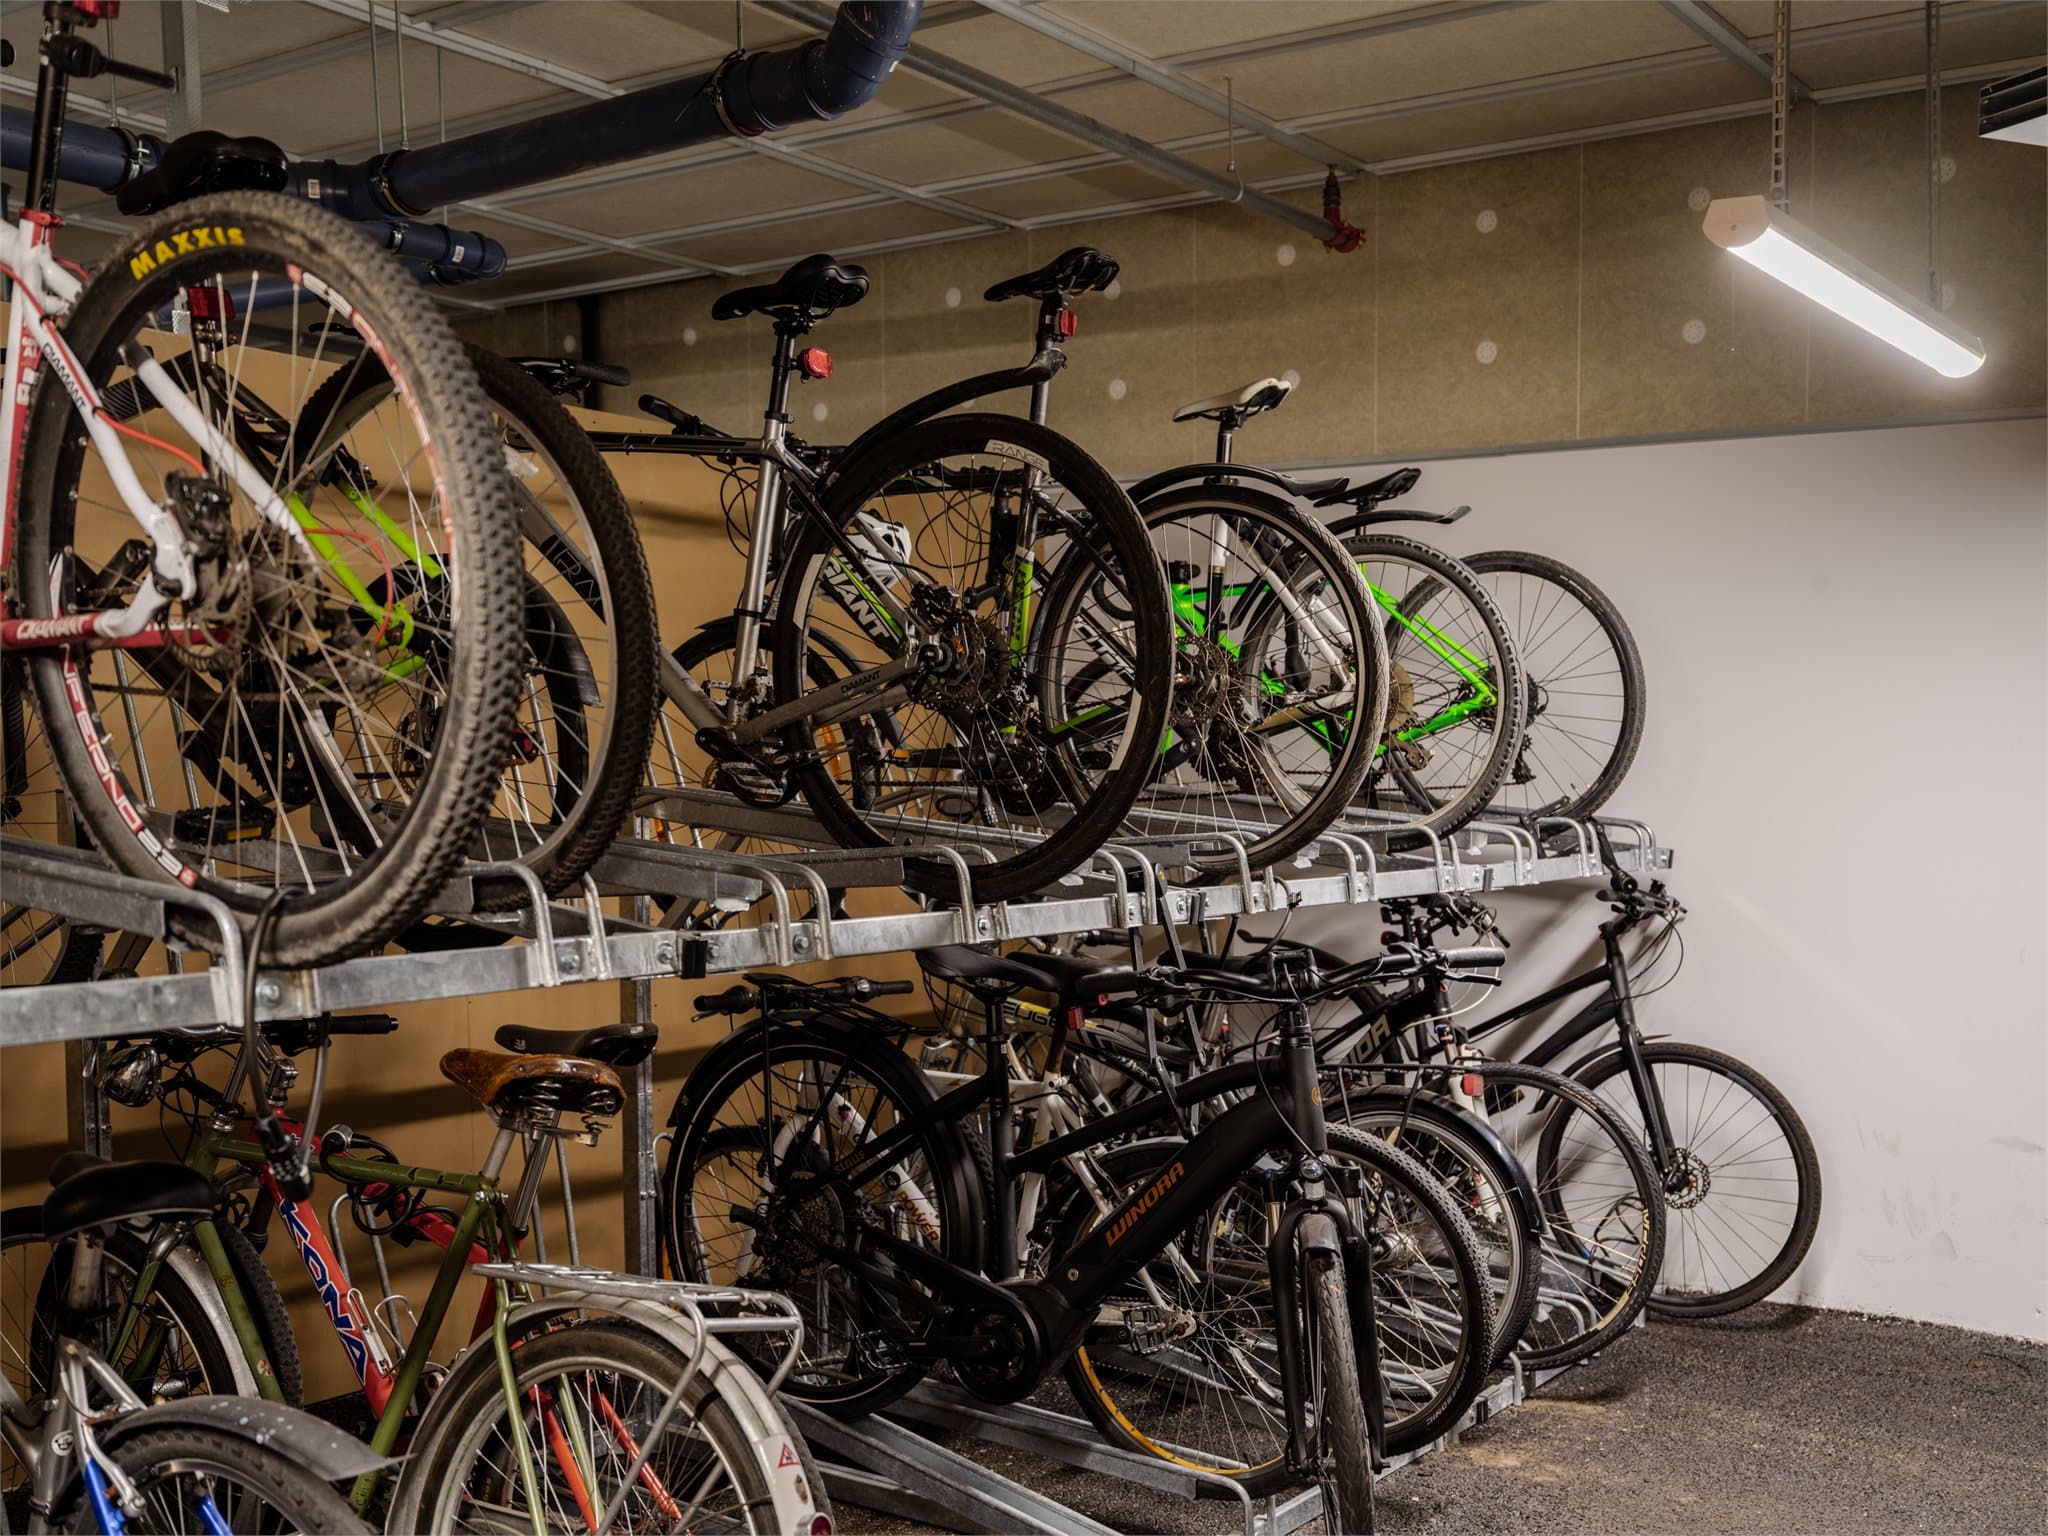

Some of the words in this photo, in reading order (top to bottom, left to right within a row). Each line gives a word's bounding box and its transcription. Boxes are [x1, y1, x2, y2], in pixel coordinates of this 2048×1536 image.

[130, 226, 245, 280] MAXXIS
[43, 342, 87, 408] DIAMANT
[992, 442, 1046, 469] RANGE
[823, 555, 890, 637] GIANT
[58, 642, 144, 834] NFERNO
[898, 1190, 940, 1241] POWER
[1105, 1161, 1185, 1247] WINORA
[279, 1199, 368, 1386] KONA
